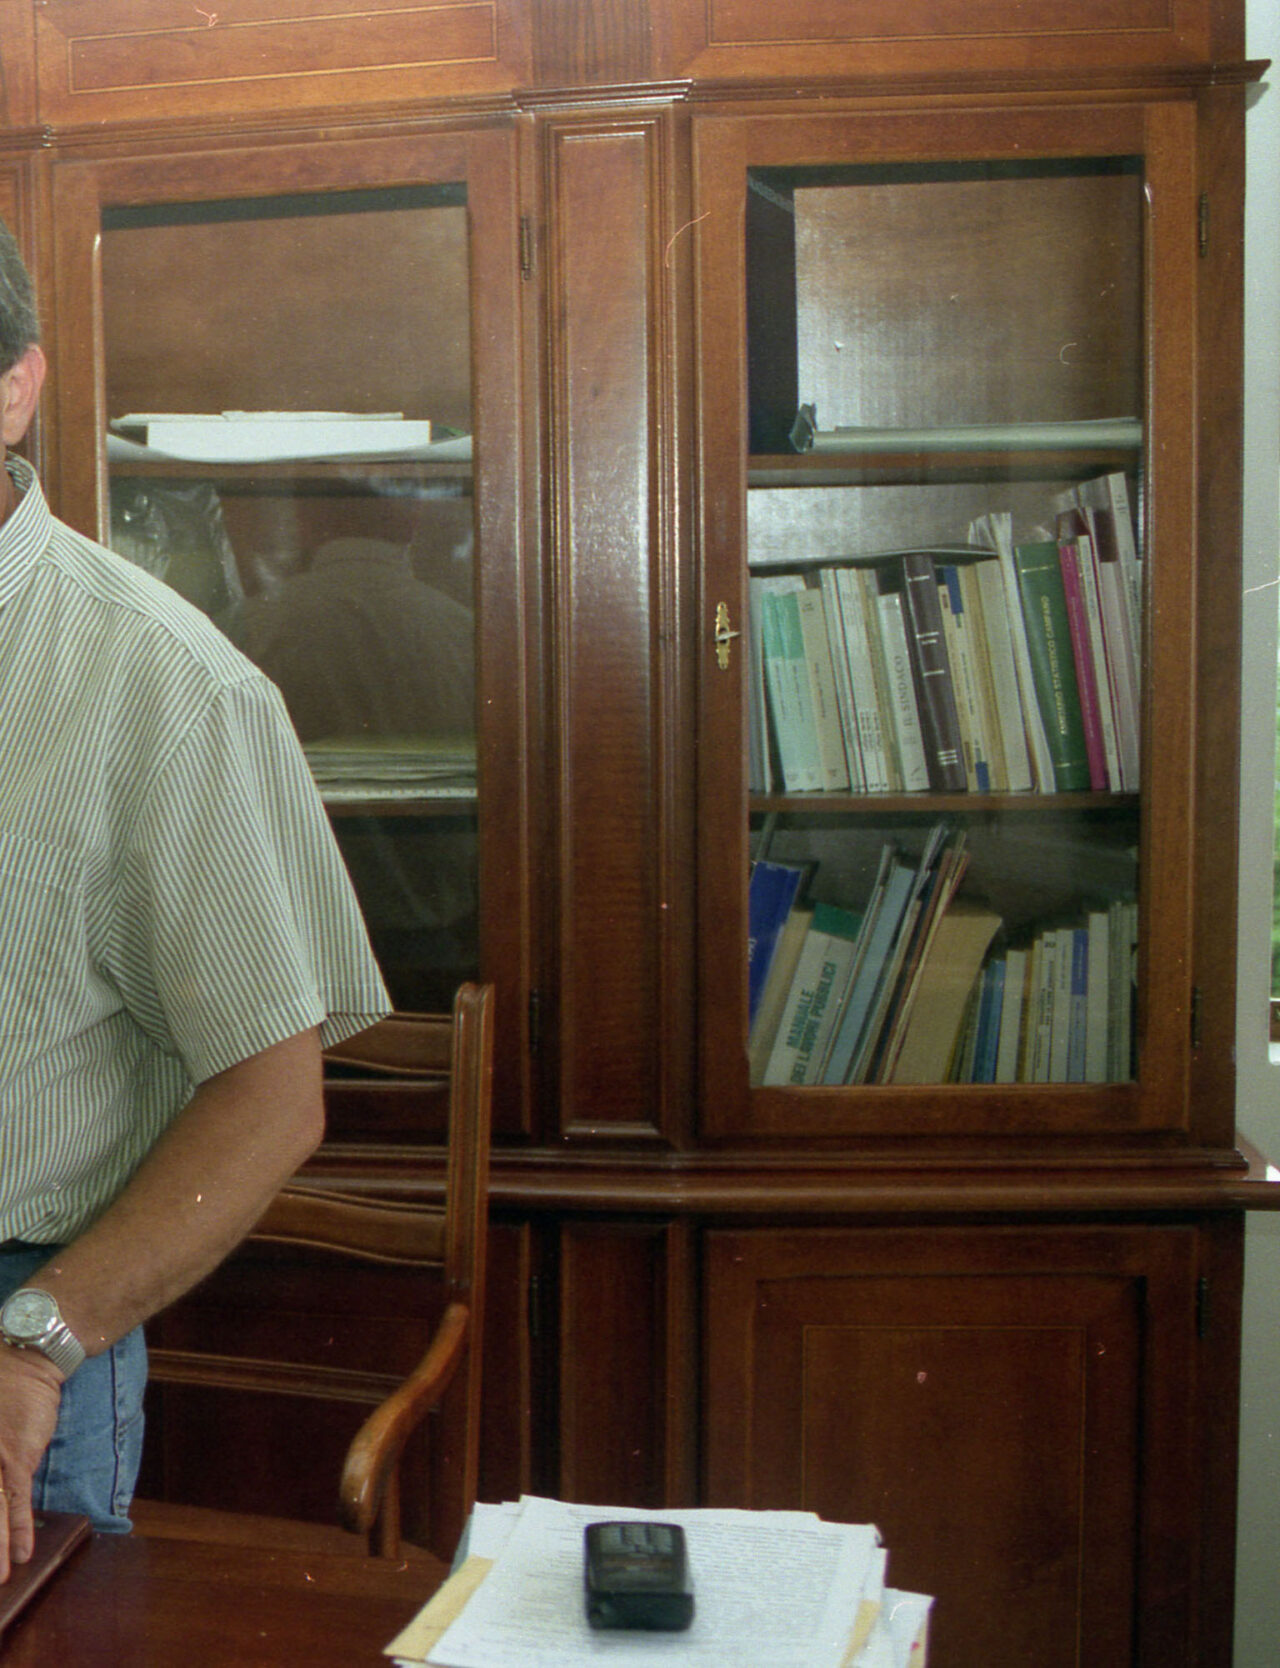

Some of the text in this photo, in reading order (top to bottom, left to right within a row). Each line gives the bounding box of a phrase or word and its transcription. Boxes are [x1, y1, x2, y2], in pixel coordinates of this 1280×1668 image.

[893, 655, 911, 711] SINDACO
[1048, 640, 1062, 689] STATISTICO
[786, 988, 815, 1049] MANUALE
[789, 961, 838, 1084] DEI LAVORI PUBBLICI
